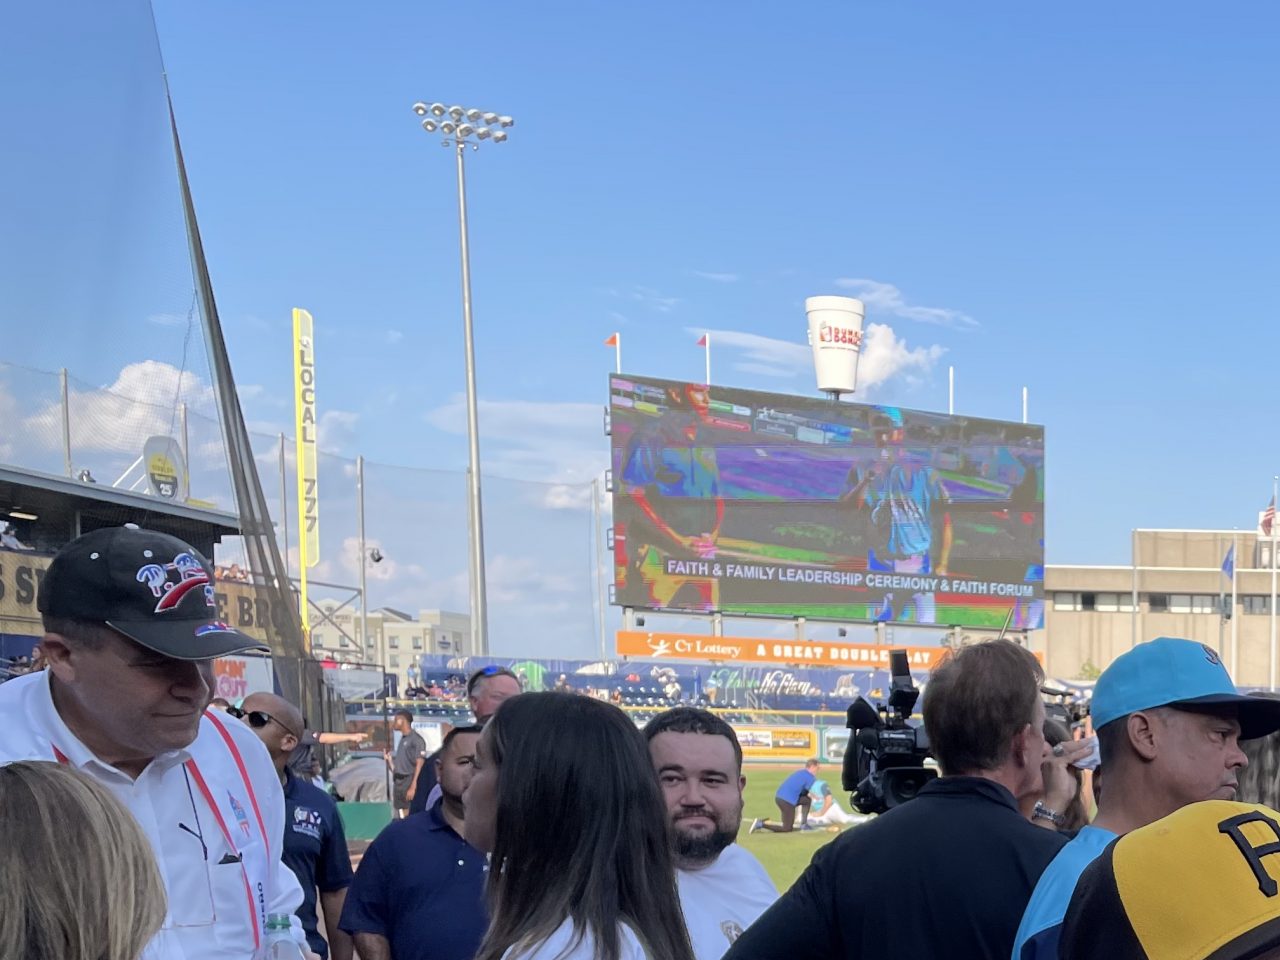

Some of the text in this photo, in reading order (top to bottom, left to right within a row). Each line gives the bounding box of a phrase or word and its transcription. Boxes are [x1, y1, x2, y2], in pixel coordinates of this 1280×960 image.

[299, 349, 317, 532] LOCAL 777
[667, 560, 1033, 597] FAITH & FAMILY LEADERSHIP CEREMONY & FAITH FORUM
[696, 640, 741, 659] Lottery
[756, 644, 766, 656] A
[773, 645, 824, 659] GREAT
[830, 647, 888, 662] DOUBLE
